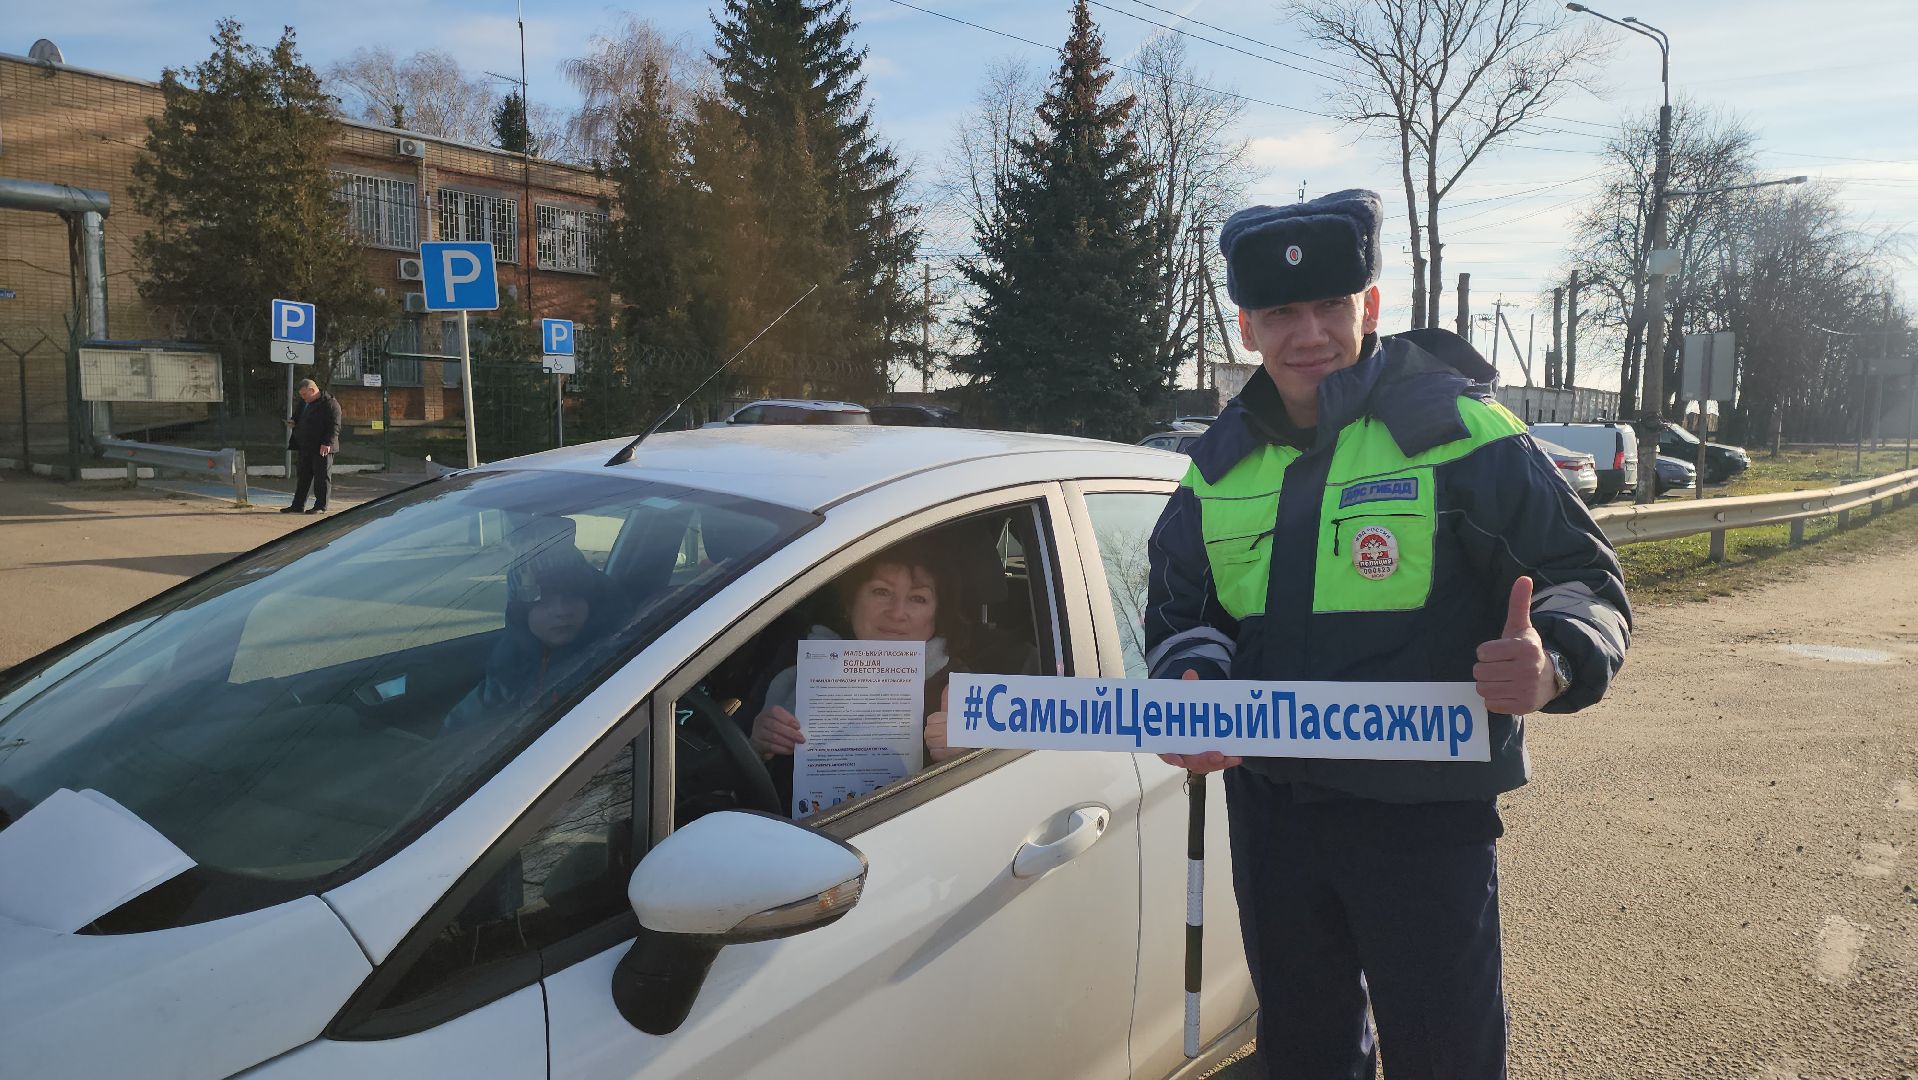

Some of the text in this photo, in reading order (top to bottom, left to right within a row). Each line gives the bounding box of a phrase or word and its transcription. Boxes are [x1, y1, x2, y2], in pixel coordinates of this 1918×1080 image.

[442, 250, 482, 303] P
[281, 304, 306, 338] P
[551, 323, 568, 350] P
[1370, 482, 1412, 494] ГИБДД
[1360, 558, 1392, 567] ПОЛИЦИЯ
[963, 684, 1474, 757] #СамыйЦенныйПассажир
